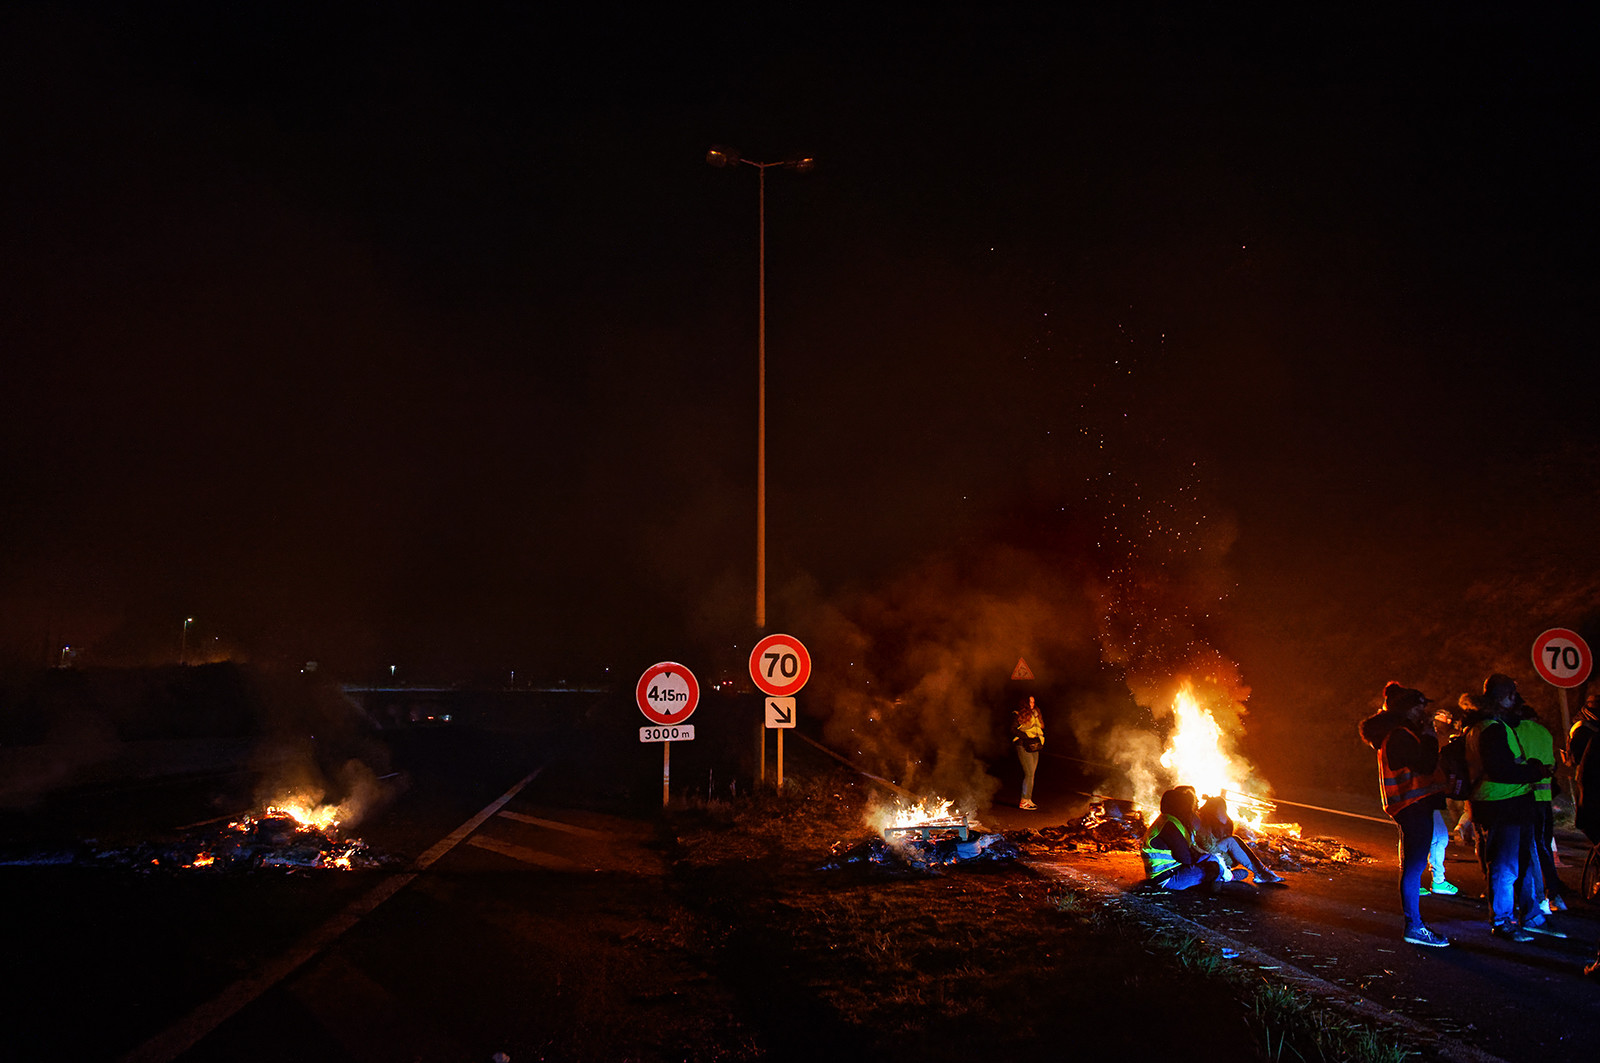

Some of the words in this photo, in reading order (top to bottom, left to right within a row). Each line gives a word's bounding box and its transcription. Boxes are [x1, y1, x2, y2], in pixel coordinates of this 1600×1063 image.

[764, 653, 798, 678] 70
[1546, 646, 1580, 670] 70
[644, 728, 679, 740] 3000
[681, 731, 690, 739] m
